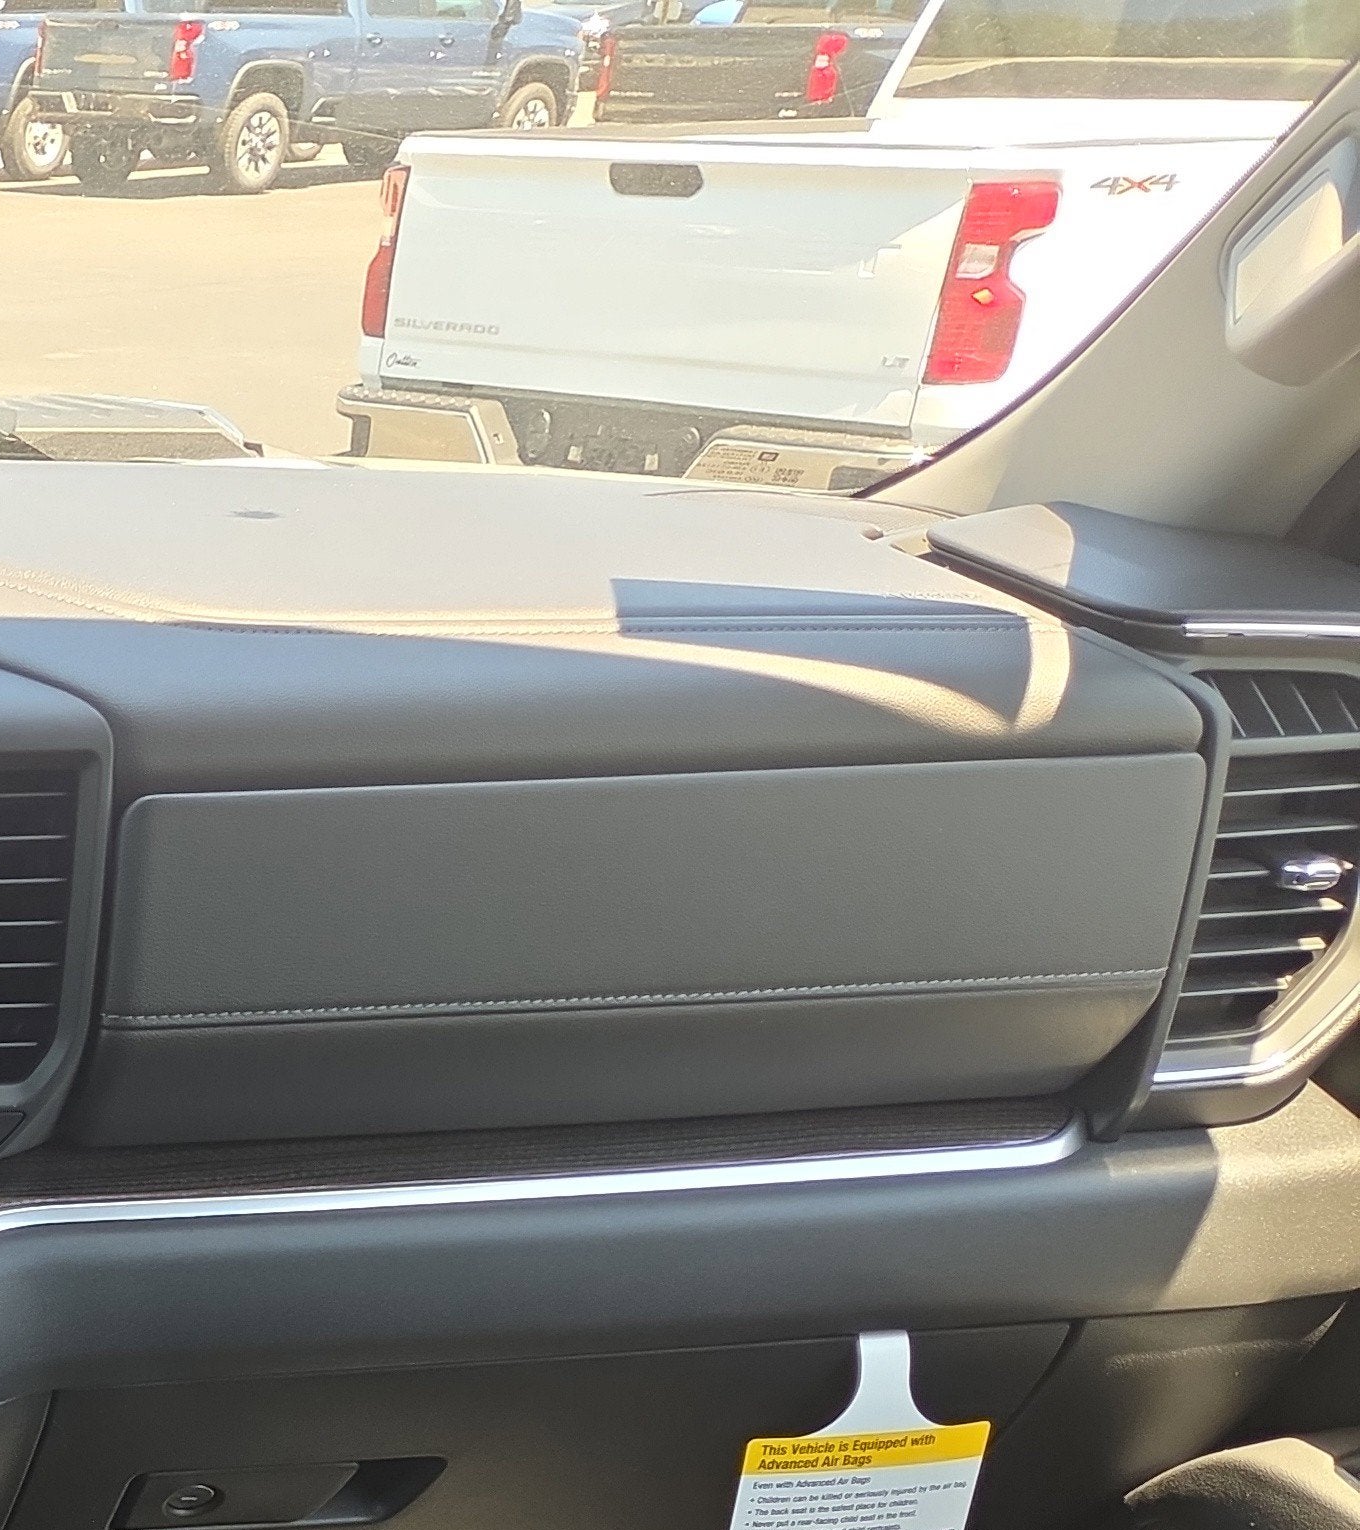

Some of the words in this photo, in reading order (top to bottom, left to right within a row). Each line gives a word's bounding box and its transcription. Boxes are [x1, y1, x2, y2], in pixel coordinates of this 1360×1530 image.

[393, 317, 500, 336] SILVERADO
[762, 1444, 786, 1456] This
[792, 1442, 835, 1454] Vehicle
[838, 1441, 849, 1453] is
[852, 1437, 907, 1453] Equipped
[911, 1434, 936, 1447] with
[758, 1456, 818, 1471] Advanced
[822, 1455, 839, 1468] Air
[842, 1454, 872, 1468] Bags
[752, 1481, 774, 1490] Even
[776, 1480, 794, 1488] with
[796, 1477, 835, 1488] Advanced
[836, 1477, 850, 1485] Air
[850, 1476, 871, 1486] Bags
[758, 1494, 791, 1504] Children
[808, 1492, 820, 1501] be
[821, 1491, 843, 1500] killed
[844, 1492, 853, 1500] or
[854, 1488, 888, 1499] seriously
[890, 1486, 916, 1498] injured
[918, 1486, 928, 1495] by
[929, 1484, 941, 1492] the
[942, 1482, 952, 1490] air
[755, 1507, 770, 1516] The
[771, 1507, 788, 1515] back
[790, 1506, 807, 1514] seat
[818, 1504, 830, 1512] the
[855, 1501, 876, 1512] place
[878, 1500, 887, 1508] for
[752, 1518, 774, 1528] Never
[776, 1518, 788, 1528] put
[840, 1514, 858, 1524] child
[859, 1512, 876, 1522] seat
[886, 1511, 898, 1519] the
